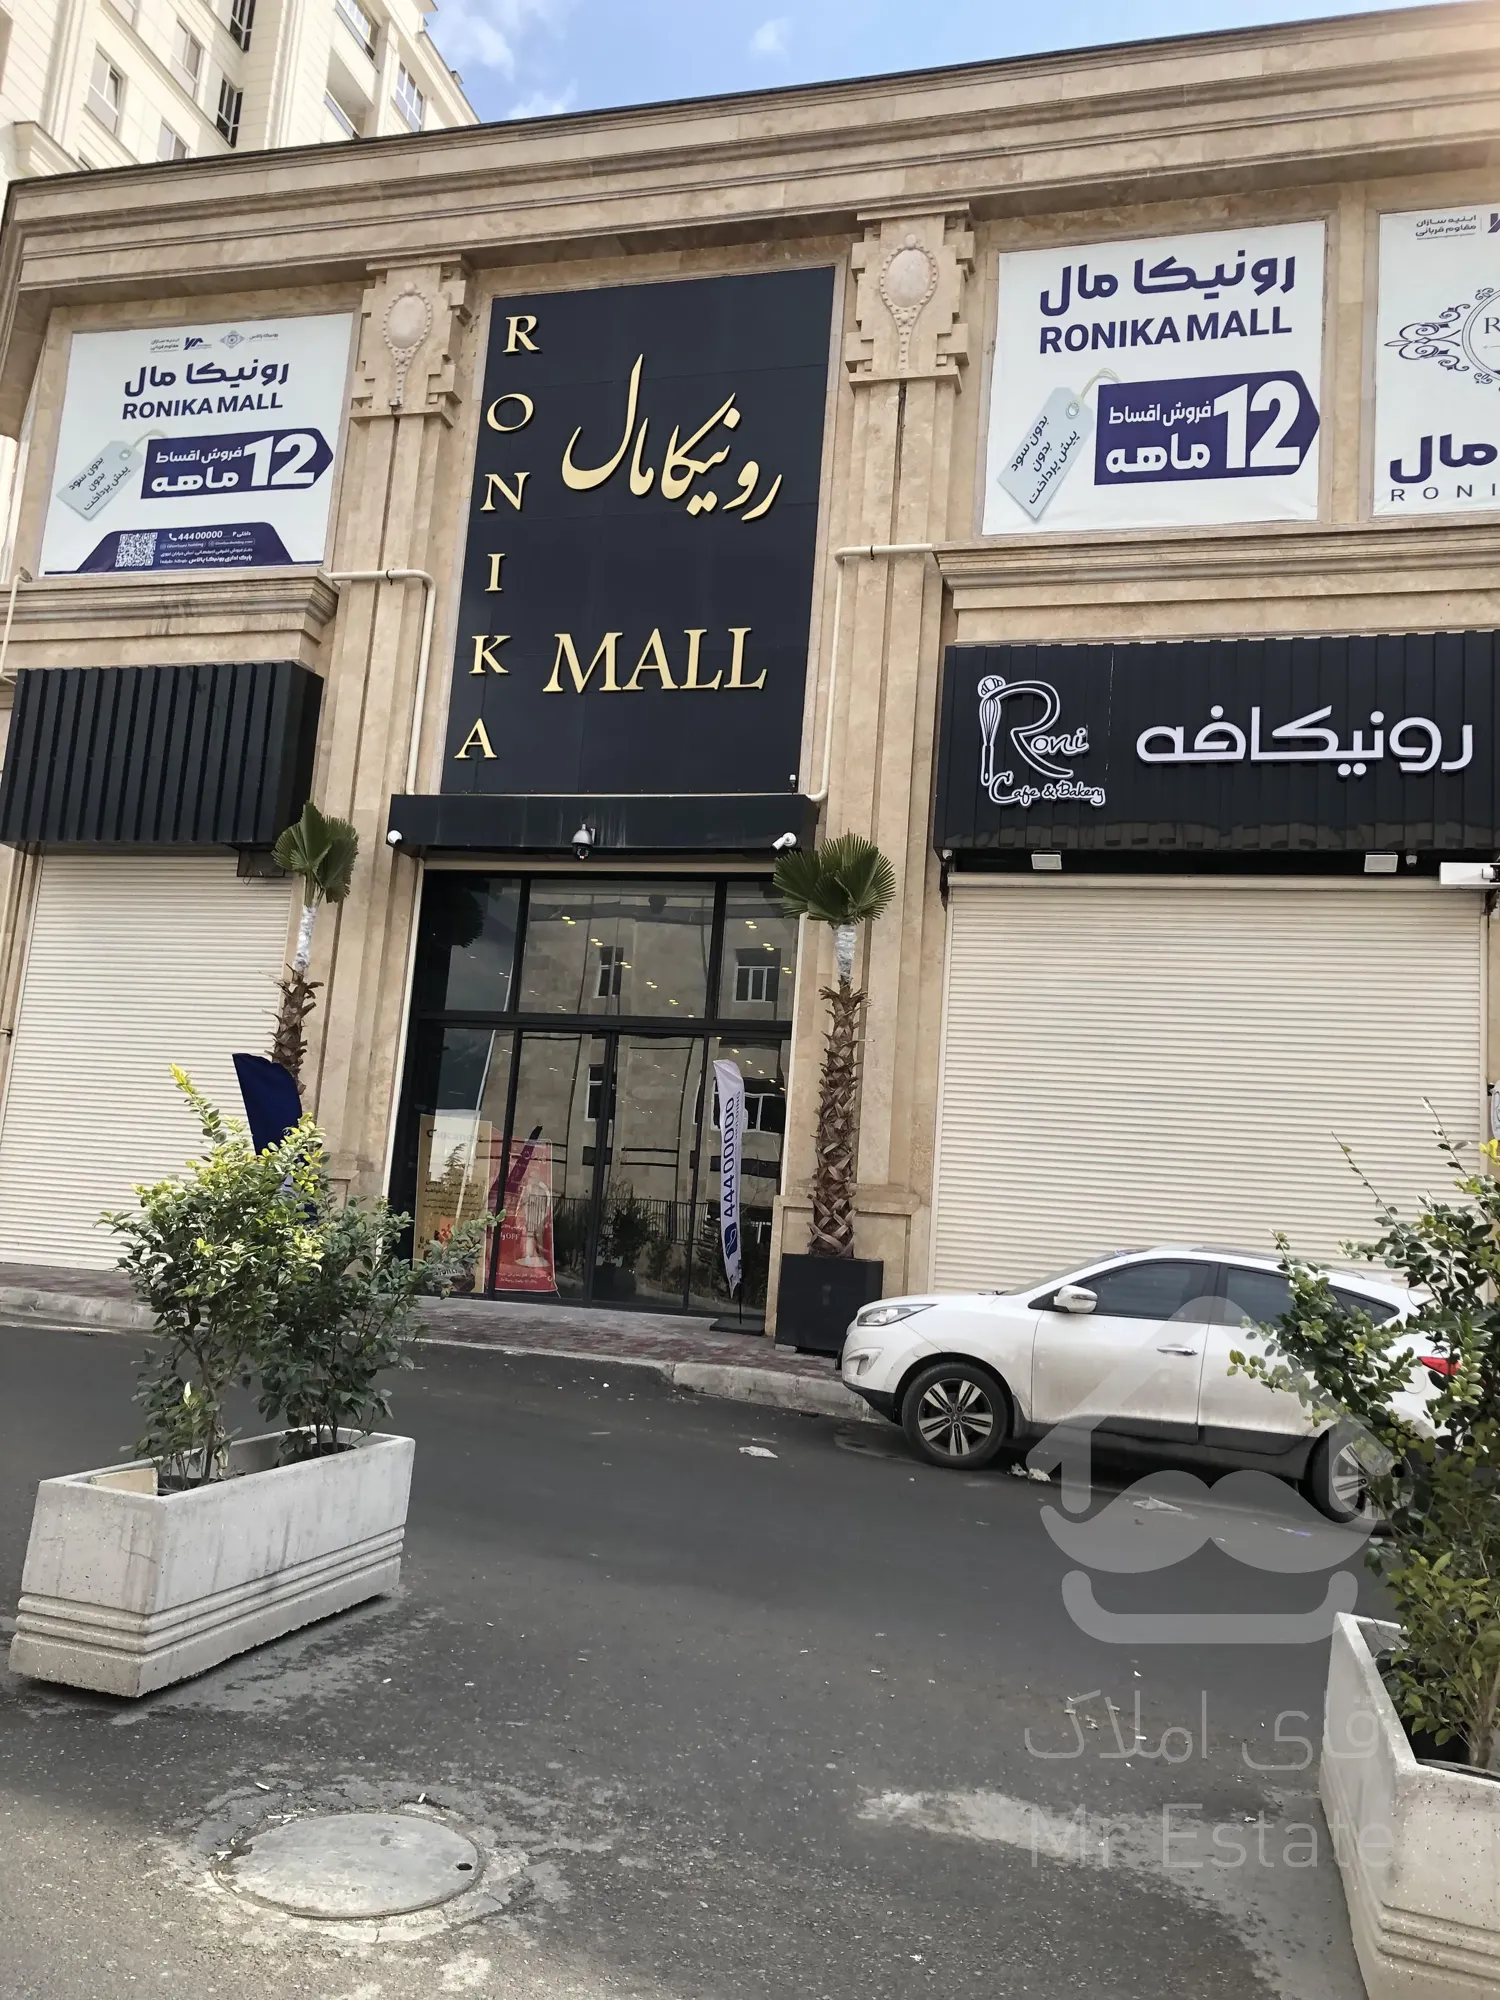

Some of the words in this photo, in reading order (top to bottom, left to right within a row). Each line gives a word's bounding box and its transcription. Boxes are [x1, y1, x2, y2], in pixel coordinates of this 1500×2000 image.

[1039, 264, 1119, 317] مال
[1133, 250, 1296, 300] رونیکا
[1039, 316, 1181, 354] RONIKA
[1186, 306, 1293, 342] MALL
[124, 365, 177, 397] مال
[186, 359, 290, 388] رونیکا
[122, 398, 213, 420] RONIKA
[216, 392, 283, 414] MALL
[1108, 403, 1161, 425] اقساط
[1162, 401, 1212, 428] فروش
[561, 354, 655, 498] مال
[1030, 416, 1049, 447] بدون
[1213, 379, 1301, 469] 12
[155, 449, 200, 464] اقساط
[201, 447, 242, 465] فروش
[244, 433, 318, 488] 12
[660, 392, 783, 522] رونیکا
[1011, 444, 1030, 472] سود
[1033, 442, 1053, 473] بدون
[1058, 431, 1080, 464] پیش
[1105, 433, 1211, 474] ماهه
[1389, 433, 1499, 484] مال
[68, 473, 88, 491] سود
[87, 457, 105, 477] بدون
[88, 472, 106, 492] بدون
[111, 466, 131, 487] پیش
[151, 466, 239, 493] ماهه
[83, 484, 113, 511] پرداخت
[1029, 461, 1062, 505] پرداخت
[1391, 483, 1497, 502] RONI
[178, 530, 223, 541] 44400000
[542, 627, 768, 694] MALL
[989, 770, 1040, 807] Cafe
[1042, 783, 1057, 799] &
[1056, 780, 1106, 806] Bakery
[722, 1096, 736, 1218] 44400000
